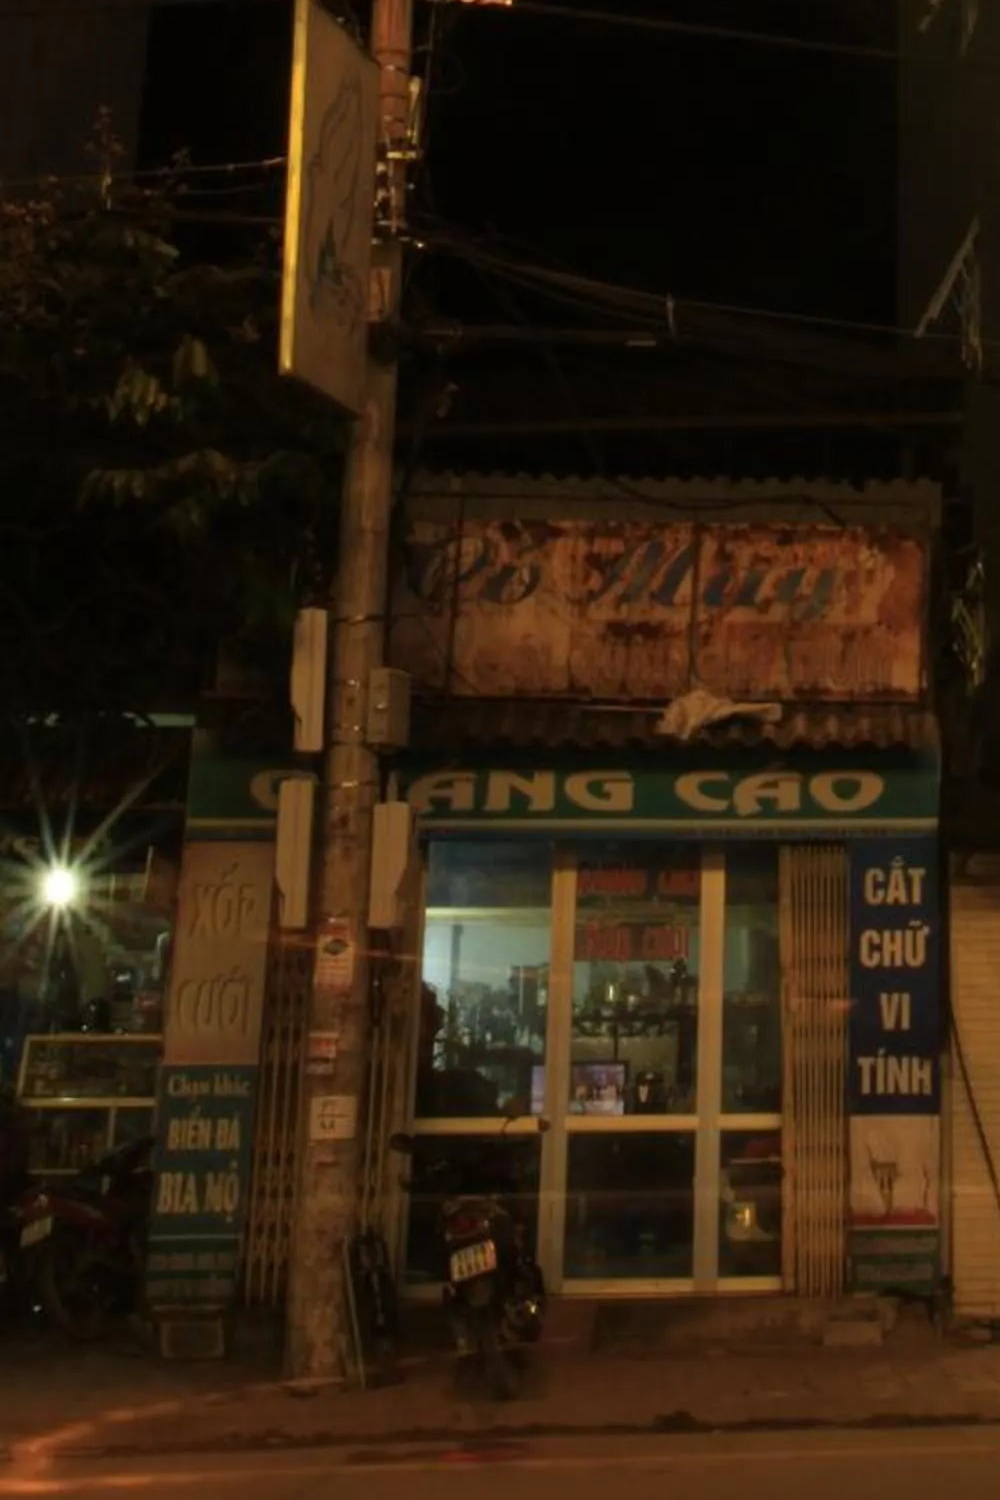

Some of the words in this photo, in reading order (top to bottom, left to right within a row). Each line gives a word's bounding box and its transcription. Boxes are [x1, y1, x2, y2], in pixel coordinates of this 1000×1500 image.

[858, 918, 930, 968] CHỮ
[879, 992, 912, 1032] VI
[857, 1046, 933, 1097] TÍNH
